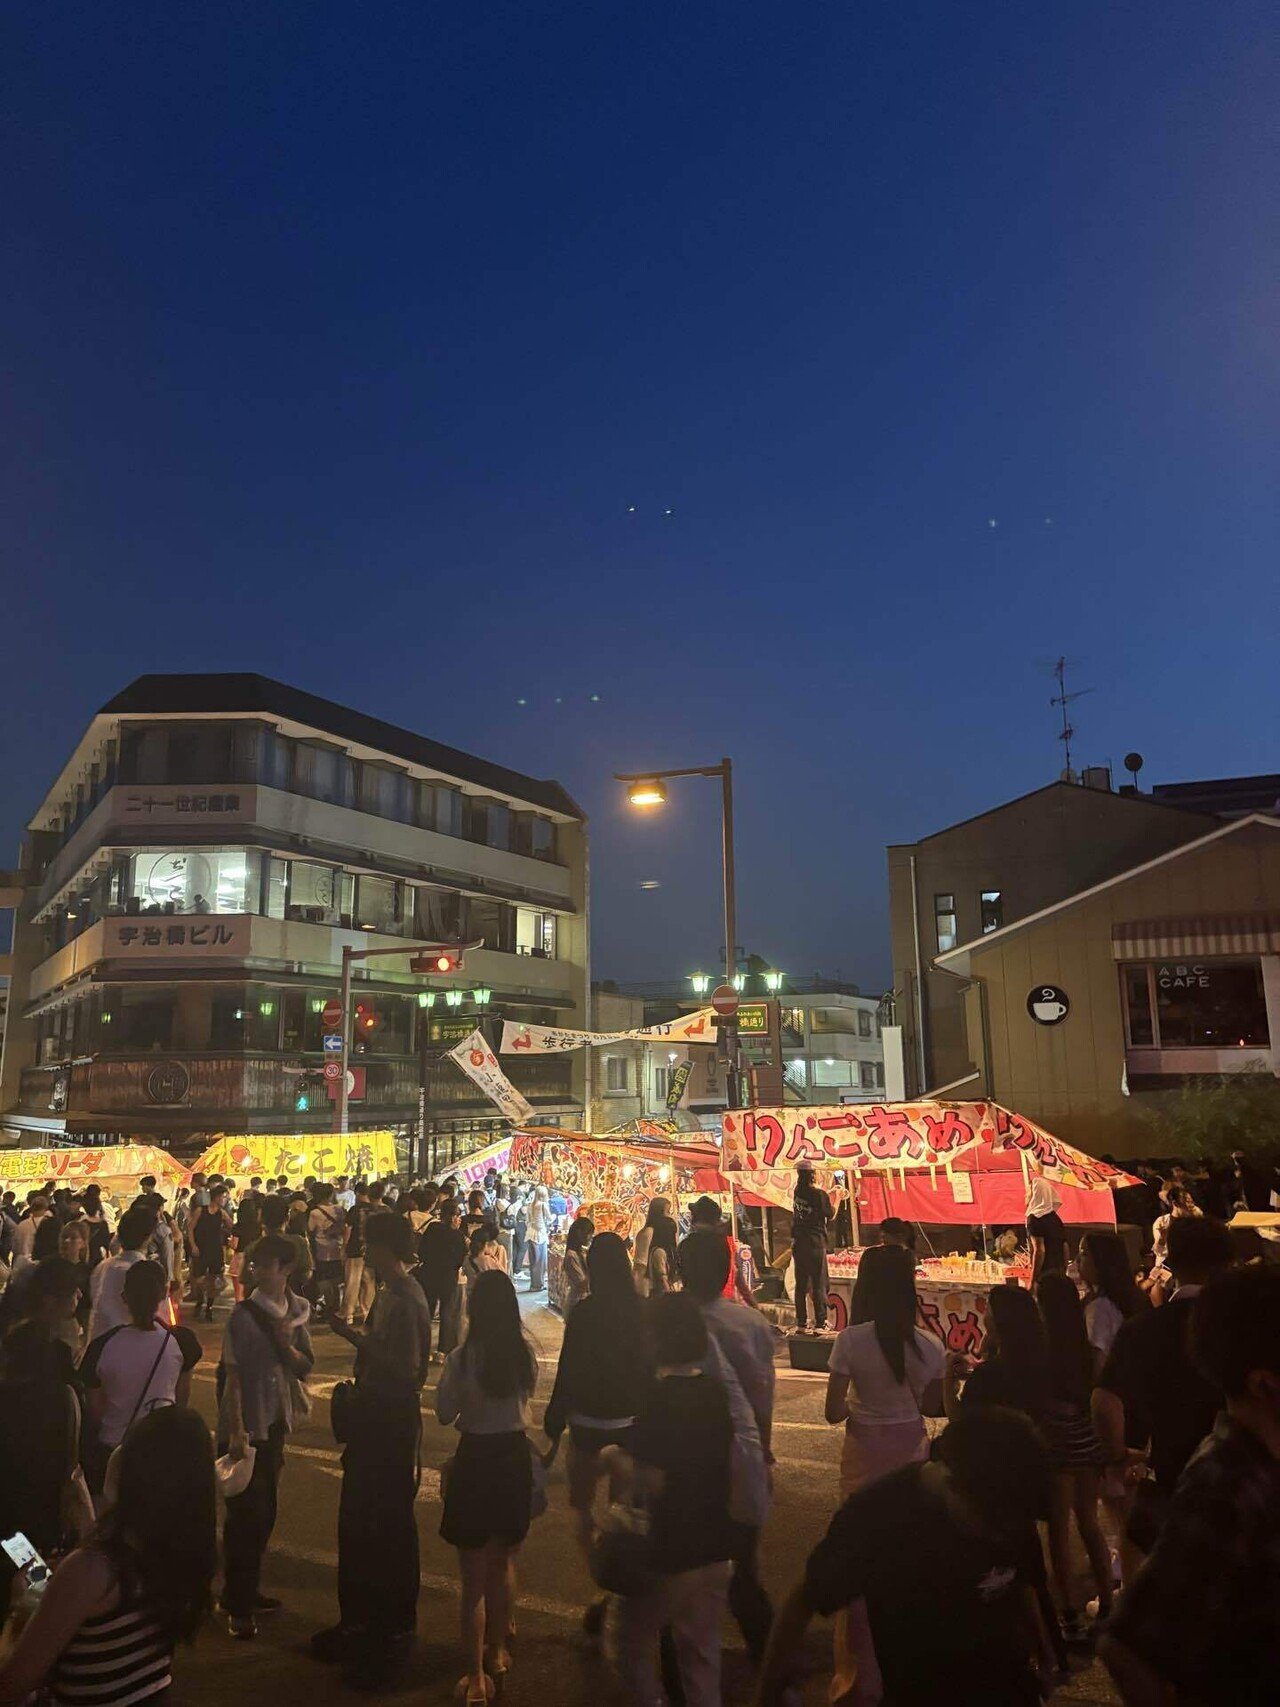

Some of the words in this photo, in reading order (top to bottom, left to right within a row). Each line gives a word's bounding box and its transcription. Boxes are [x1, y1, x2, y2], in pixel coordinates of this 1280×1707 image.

[118, 924, 233, 946] 宇治橋ビル
[1159, 976, 1210, 988] CAFE
[327, 1066, 338, 1075] 30
[742, 1106, 976, 1168] りんごあめ
[1, 1152, 105, 1179] 電球ソーダ
